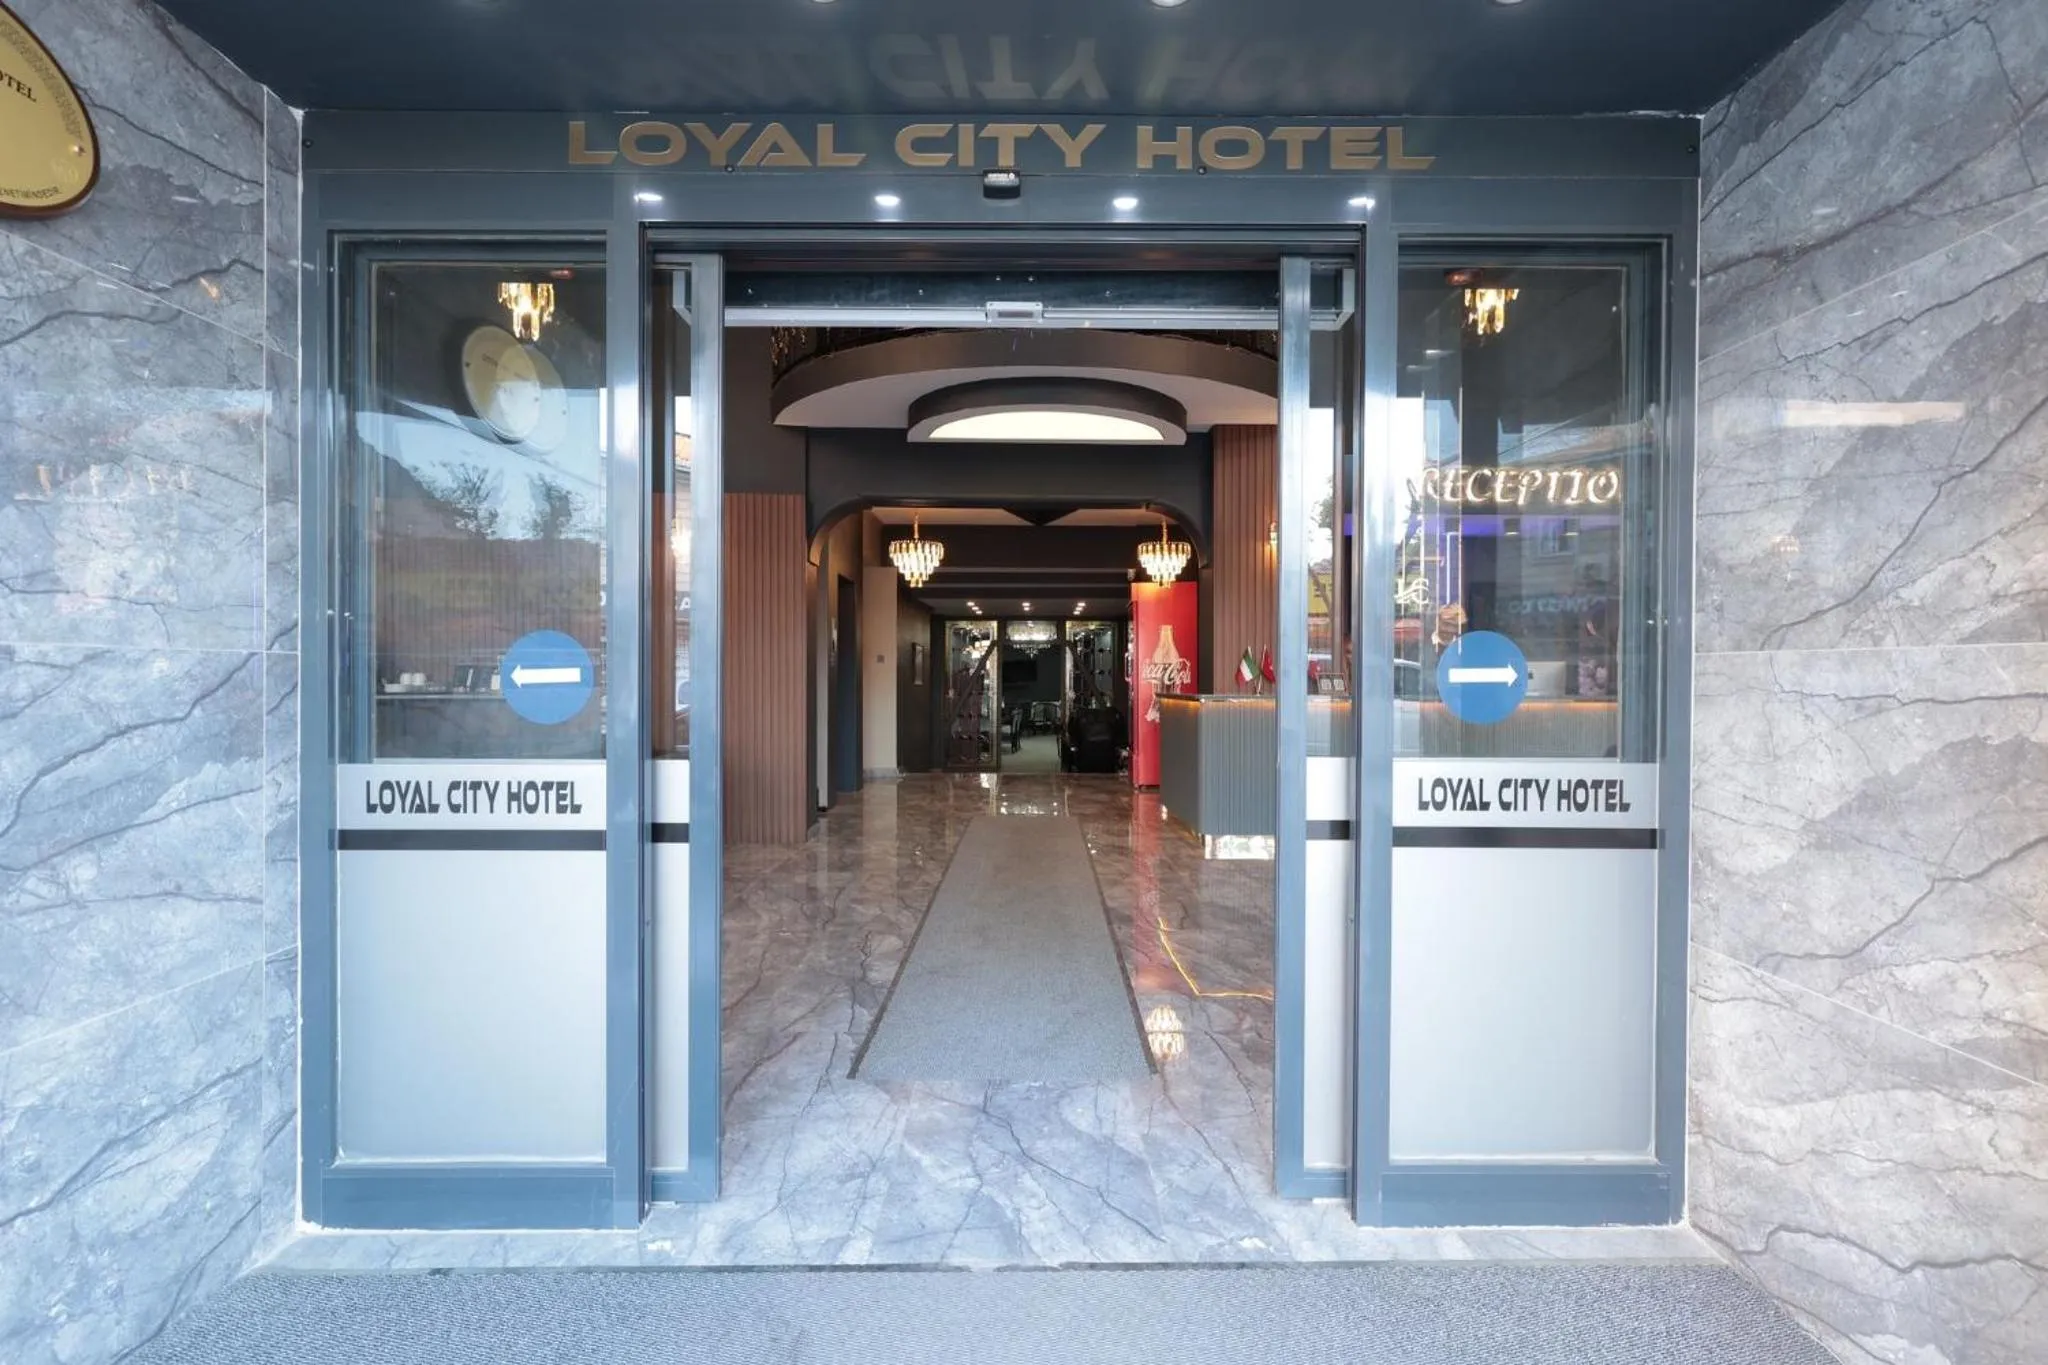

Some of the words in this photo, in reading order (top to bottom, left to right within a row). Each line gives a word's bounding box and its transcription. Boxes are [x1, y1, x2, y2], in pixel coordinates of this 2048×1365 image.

[568, 121, 867, 167] LOYAL
[894, 123, 1106, 168] CITY
[1136, 126, 1437, 170] HOTEL
[366, 780, 440, 814] LOYAL
[447, 780, 499, 814] CITY
[507, 781, 582, 814] HOTEL
[1418, 777, 1491, 812] LOYAL
[1498, 778, 1550, 812] CITY
[1557, 779, 1631, 813] HOTEL
